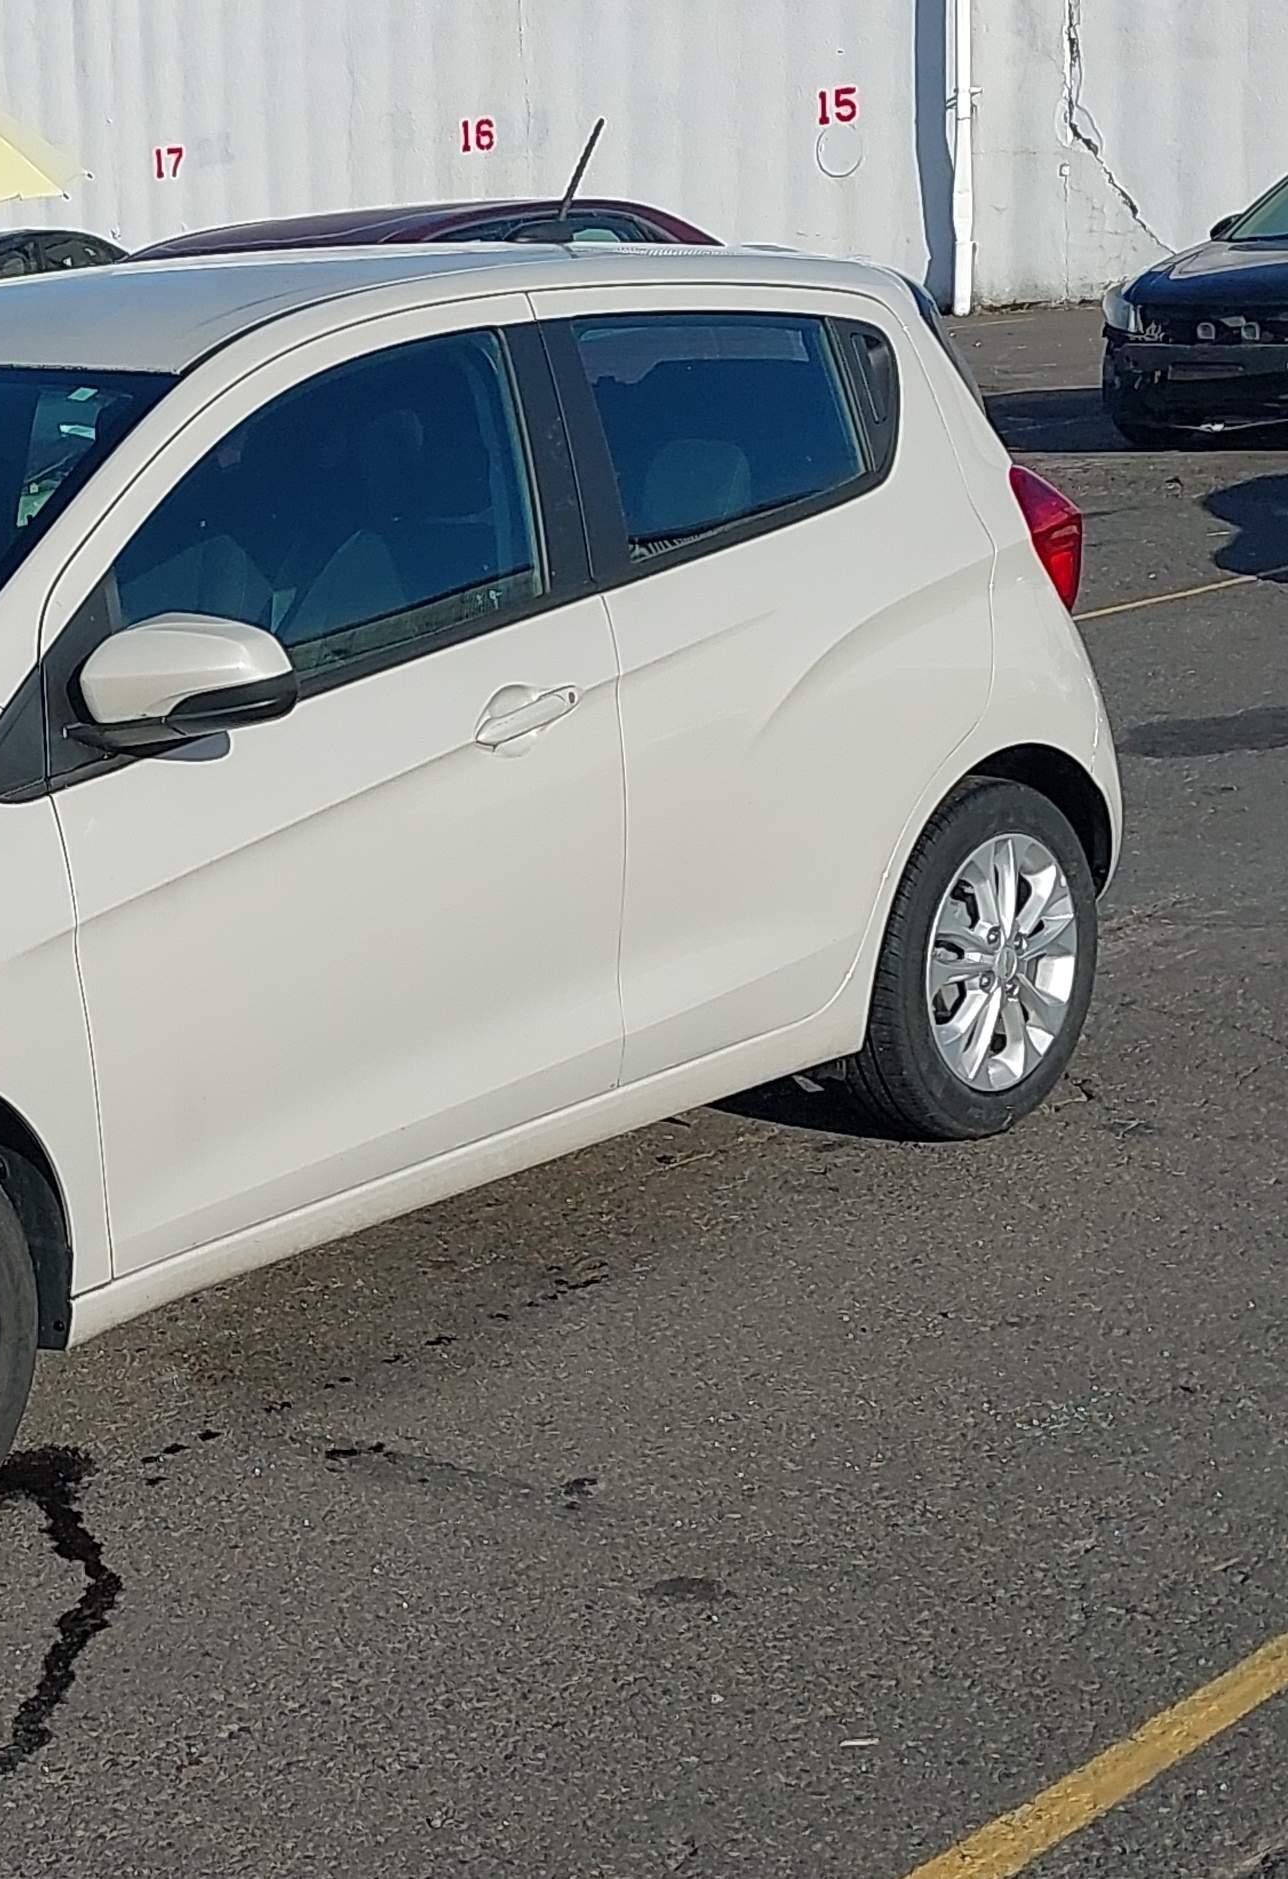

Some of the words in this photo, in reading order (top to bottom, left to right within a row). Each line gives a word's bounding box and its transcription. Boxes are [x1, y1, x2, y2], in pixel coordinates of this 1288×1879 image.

[818, 86, 857, 126] 15
[461, 118, 494, 152] 16
[155, 146, 183, 179] 17
